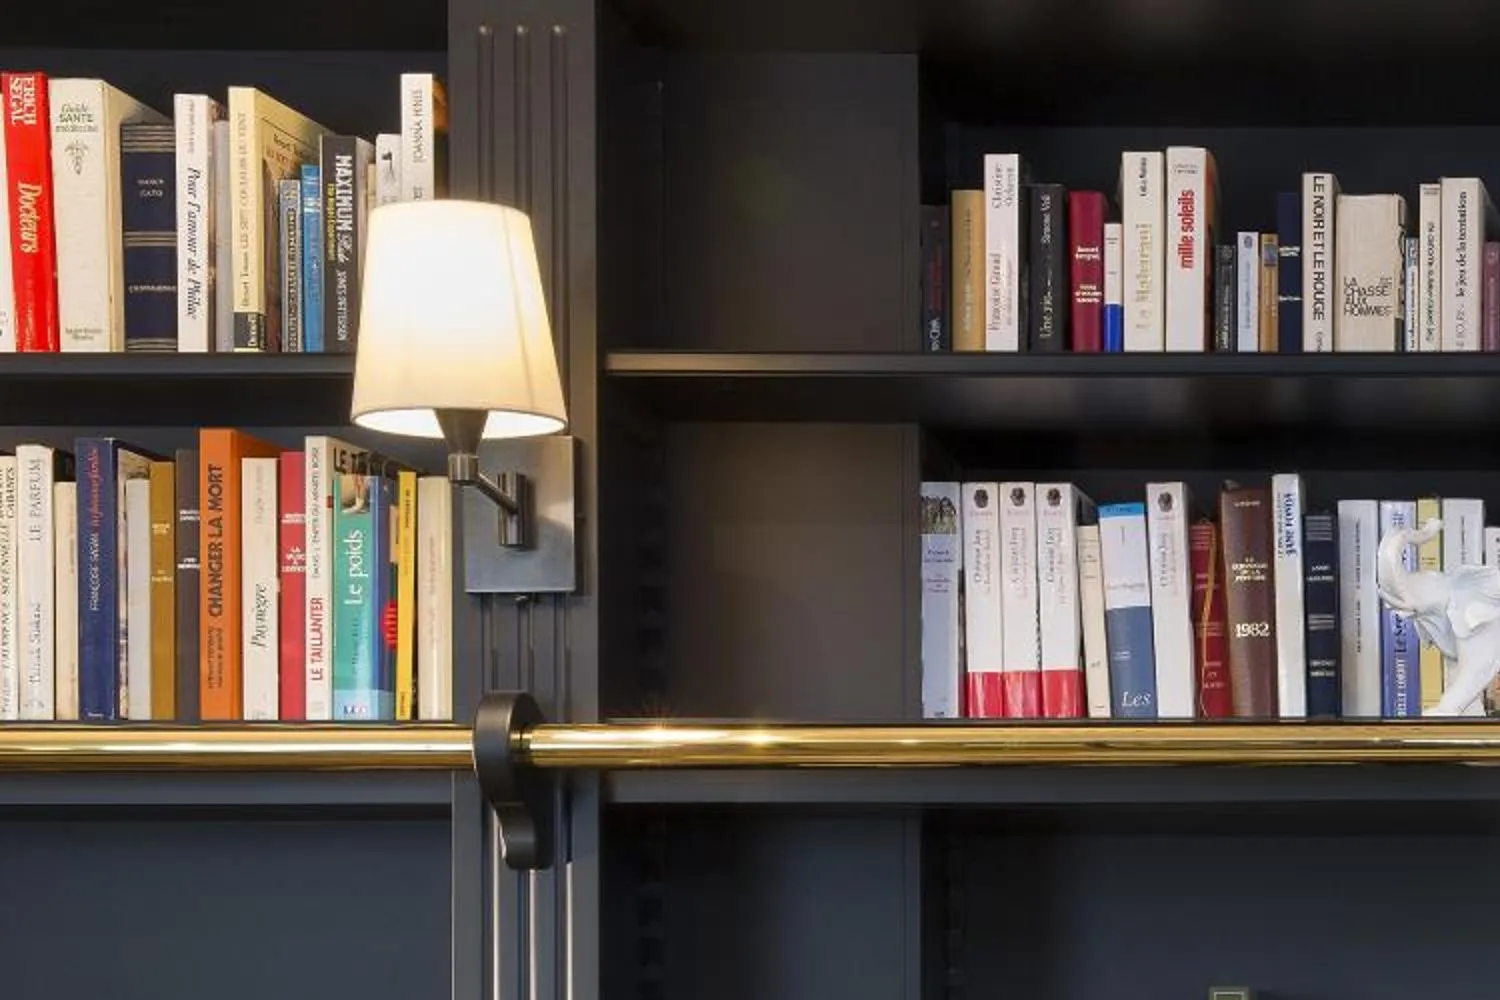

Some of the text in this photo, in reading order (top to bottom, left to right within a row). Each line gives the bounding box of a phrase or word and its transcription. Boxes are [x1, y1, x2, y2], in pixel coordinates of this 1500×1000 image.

[10, 77, 23, 125] SEGAL
[23, 77, 36, 125] ERICH
[187, 167, 201, 197] Pour
[336, 155, 353, 230] MAXIMUM
[1313, 175, 1326, 192] LE
[18, 182, 42, 254] Docteurs
[187, 201, 201, 255] l'amour
[1177, 190, 1195, 269] mille soleils
[1313, 195, 1326, 229] NOIR
[1455, 191, 1467, 240] tentation
[1313, 231, 1325, 250] ET
[1313, 251, 1325, 269] LE
[1455, 252, 1465, 267] de
[187, 259, 201, 273] de
[1312, 271, 1325, 321] ROUGE
[28, 459, 42, 542] LE PARFUM
[208, 464, 223, 512] MORT
[208, 516, 223, 537] LA
[343, 529, 368, 578] poids
[208, 541, 223, 617] CHANGER
[343, 584, 364, 605] Le
[310, 597, 324, 681] LE TAILLANTER
[1234, 623, 1270, 638] 1982
[1121, 692, 1151, 708] Les
